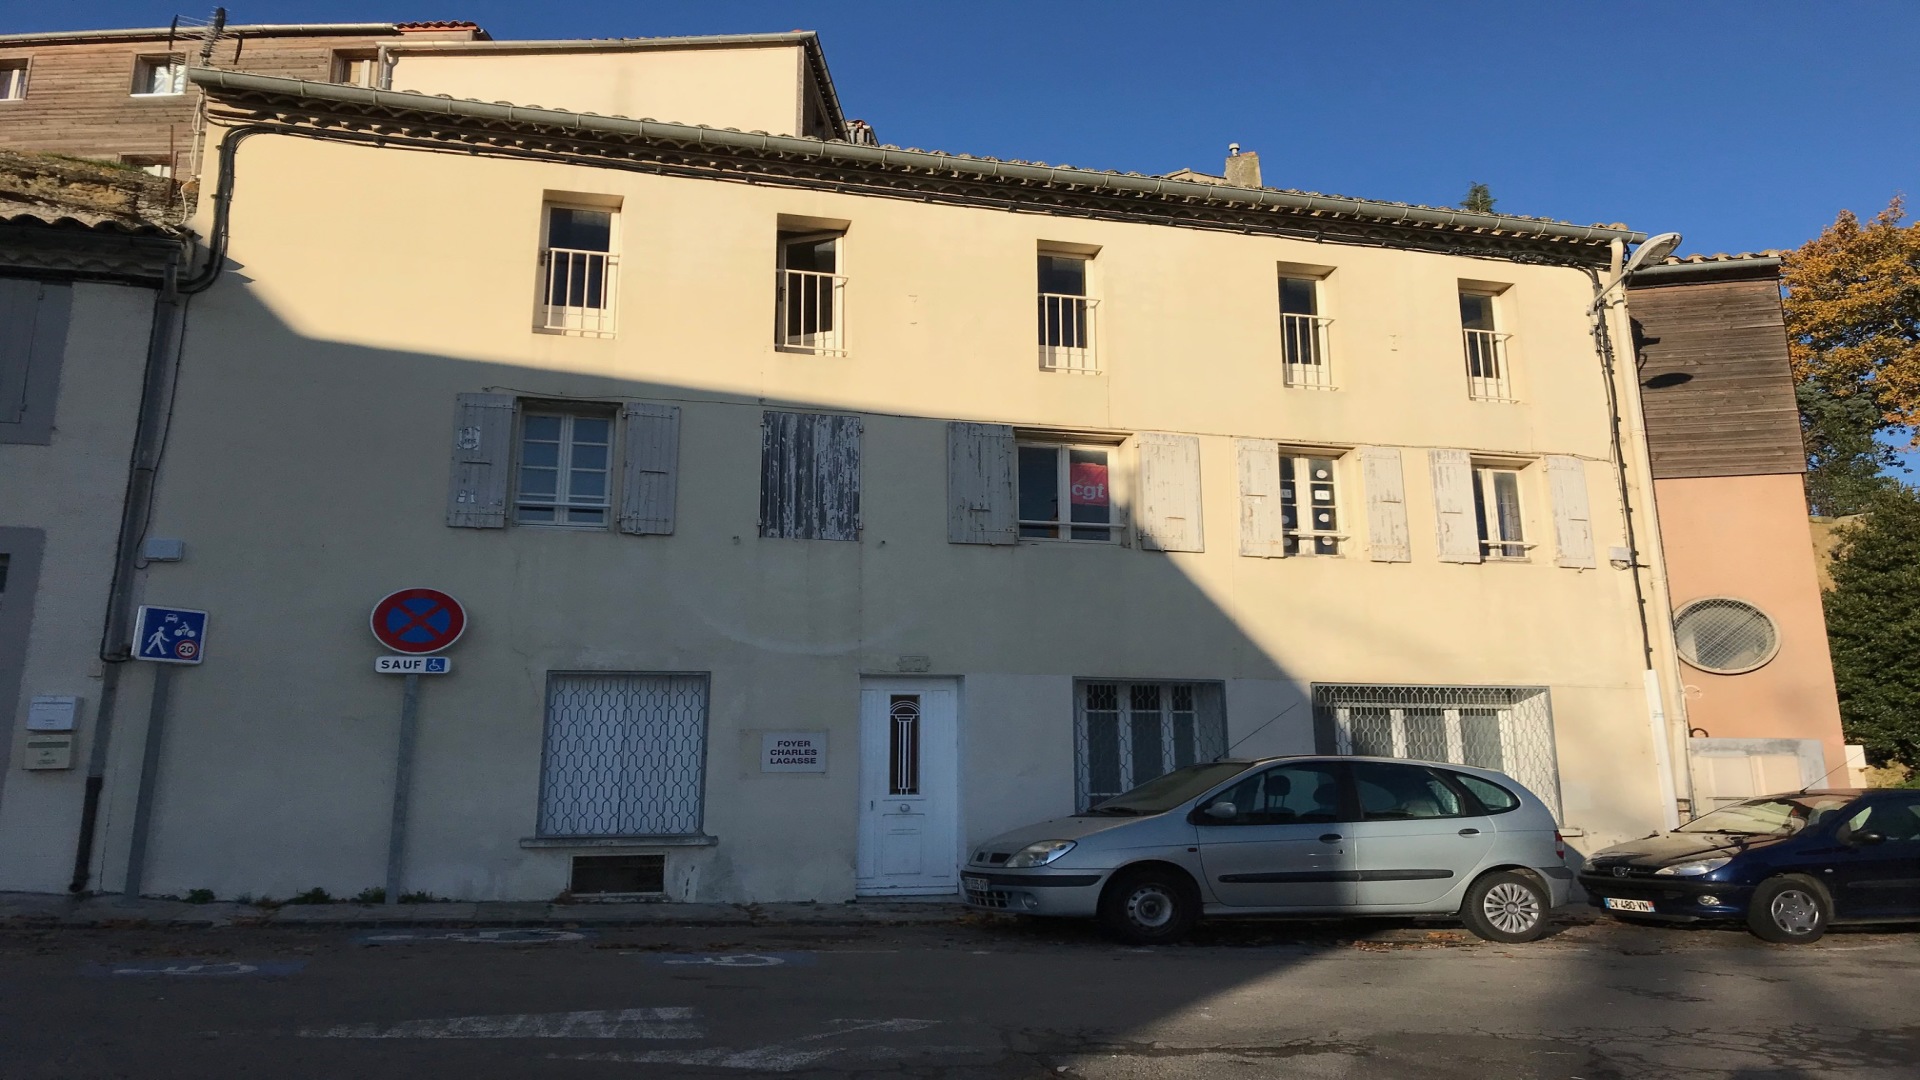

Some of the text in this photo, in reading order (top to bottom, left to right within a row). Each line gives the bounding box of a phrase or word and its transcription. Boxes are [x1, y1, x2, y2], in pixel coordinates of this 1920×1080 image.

[1072, 484, 1104, 500] cgt
[180, 645, 194, 654] 20
[381, 660, 421, 669] SAUF
[770, 757, 817, 765] LAGASSE
